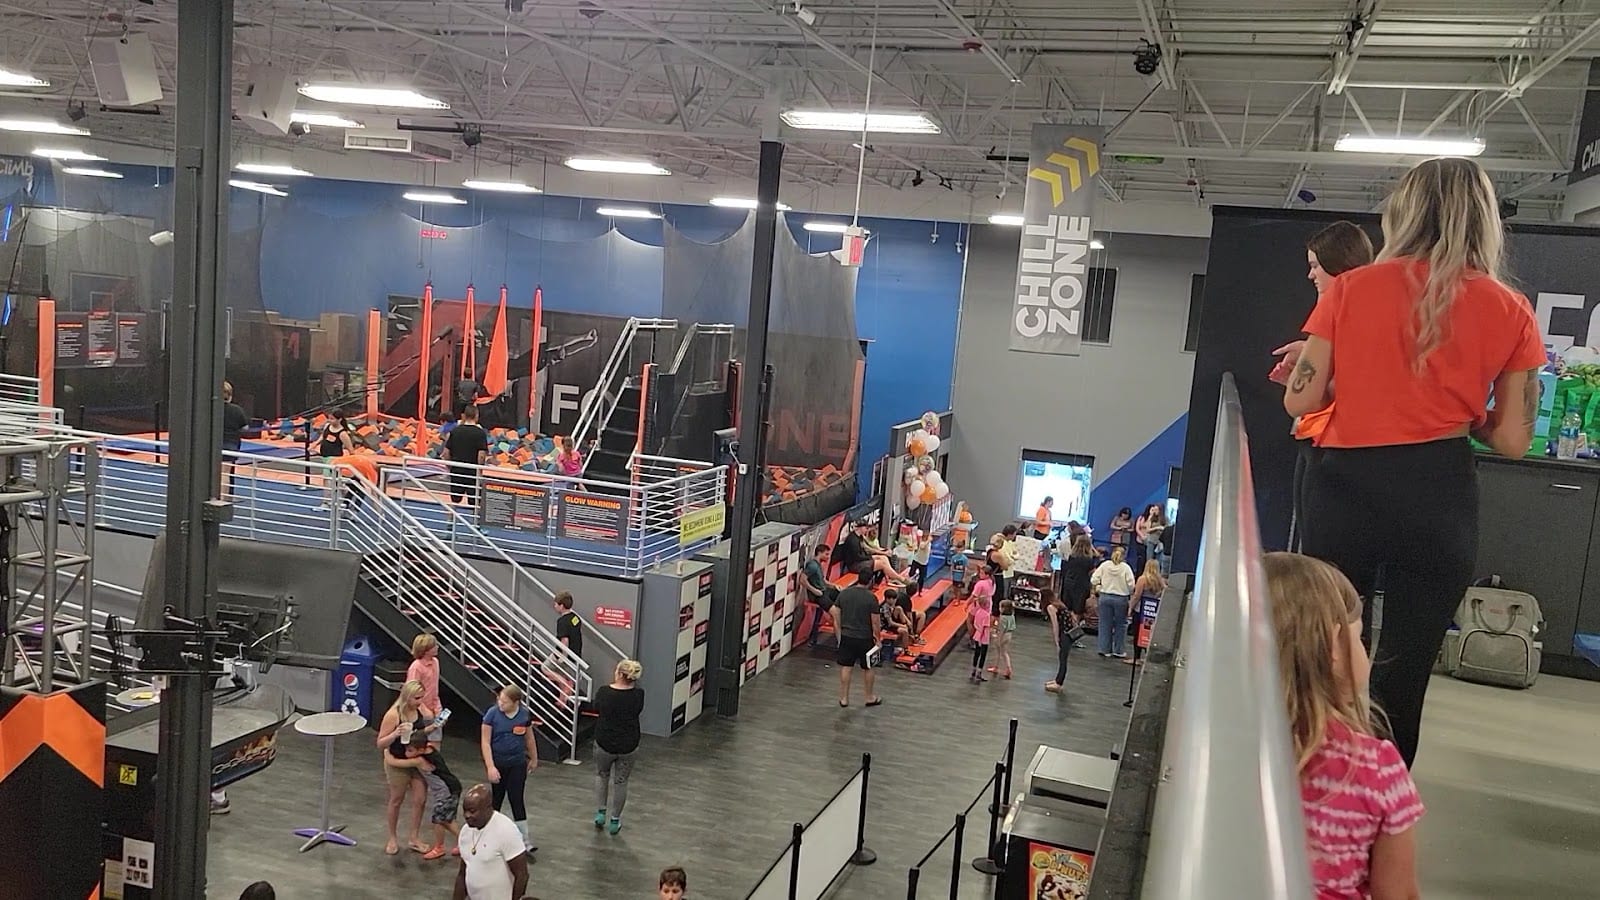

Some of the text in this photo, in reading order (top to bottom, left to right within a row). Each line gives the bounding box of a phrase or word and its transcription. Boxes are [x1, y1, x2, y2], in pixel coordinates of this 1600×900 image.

[1015, 214, 1058, 337] CHILL
[1047, 215, 1091, 335] ZONE
[565, 495, 621, 510] GLOW WARNING
